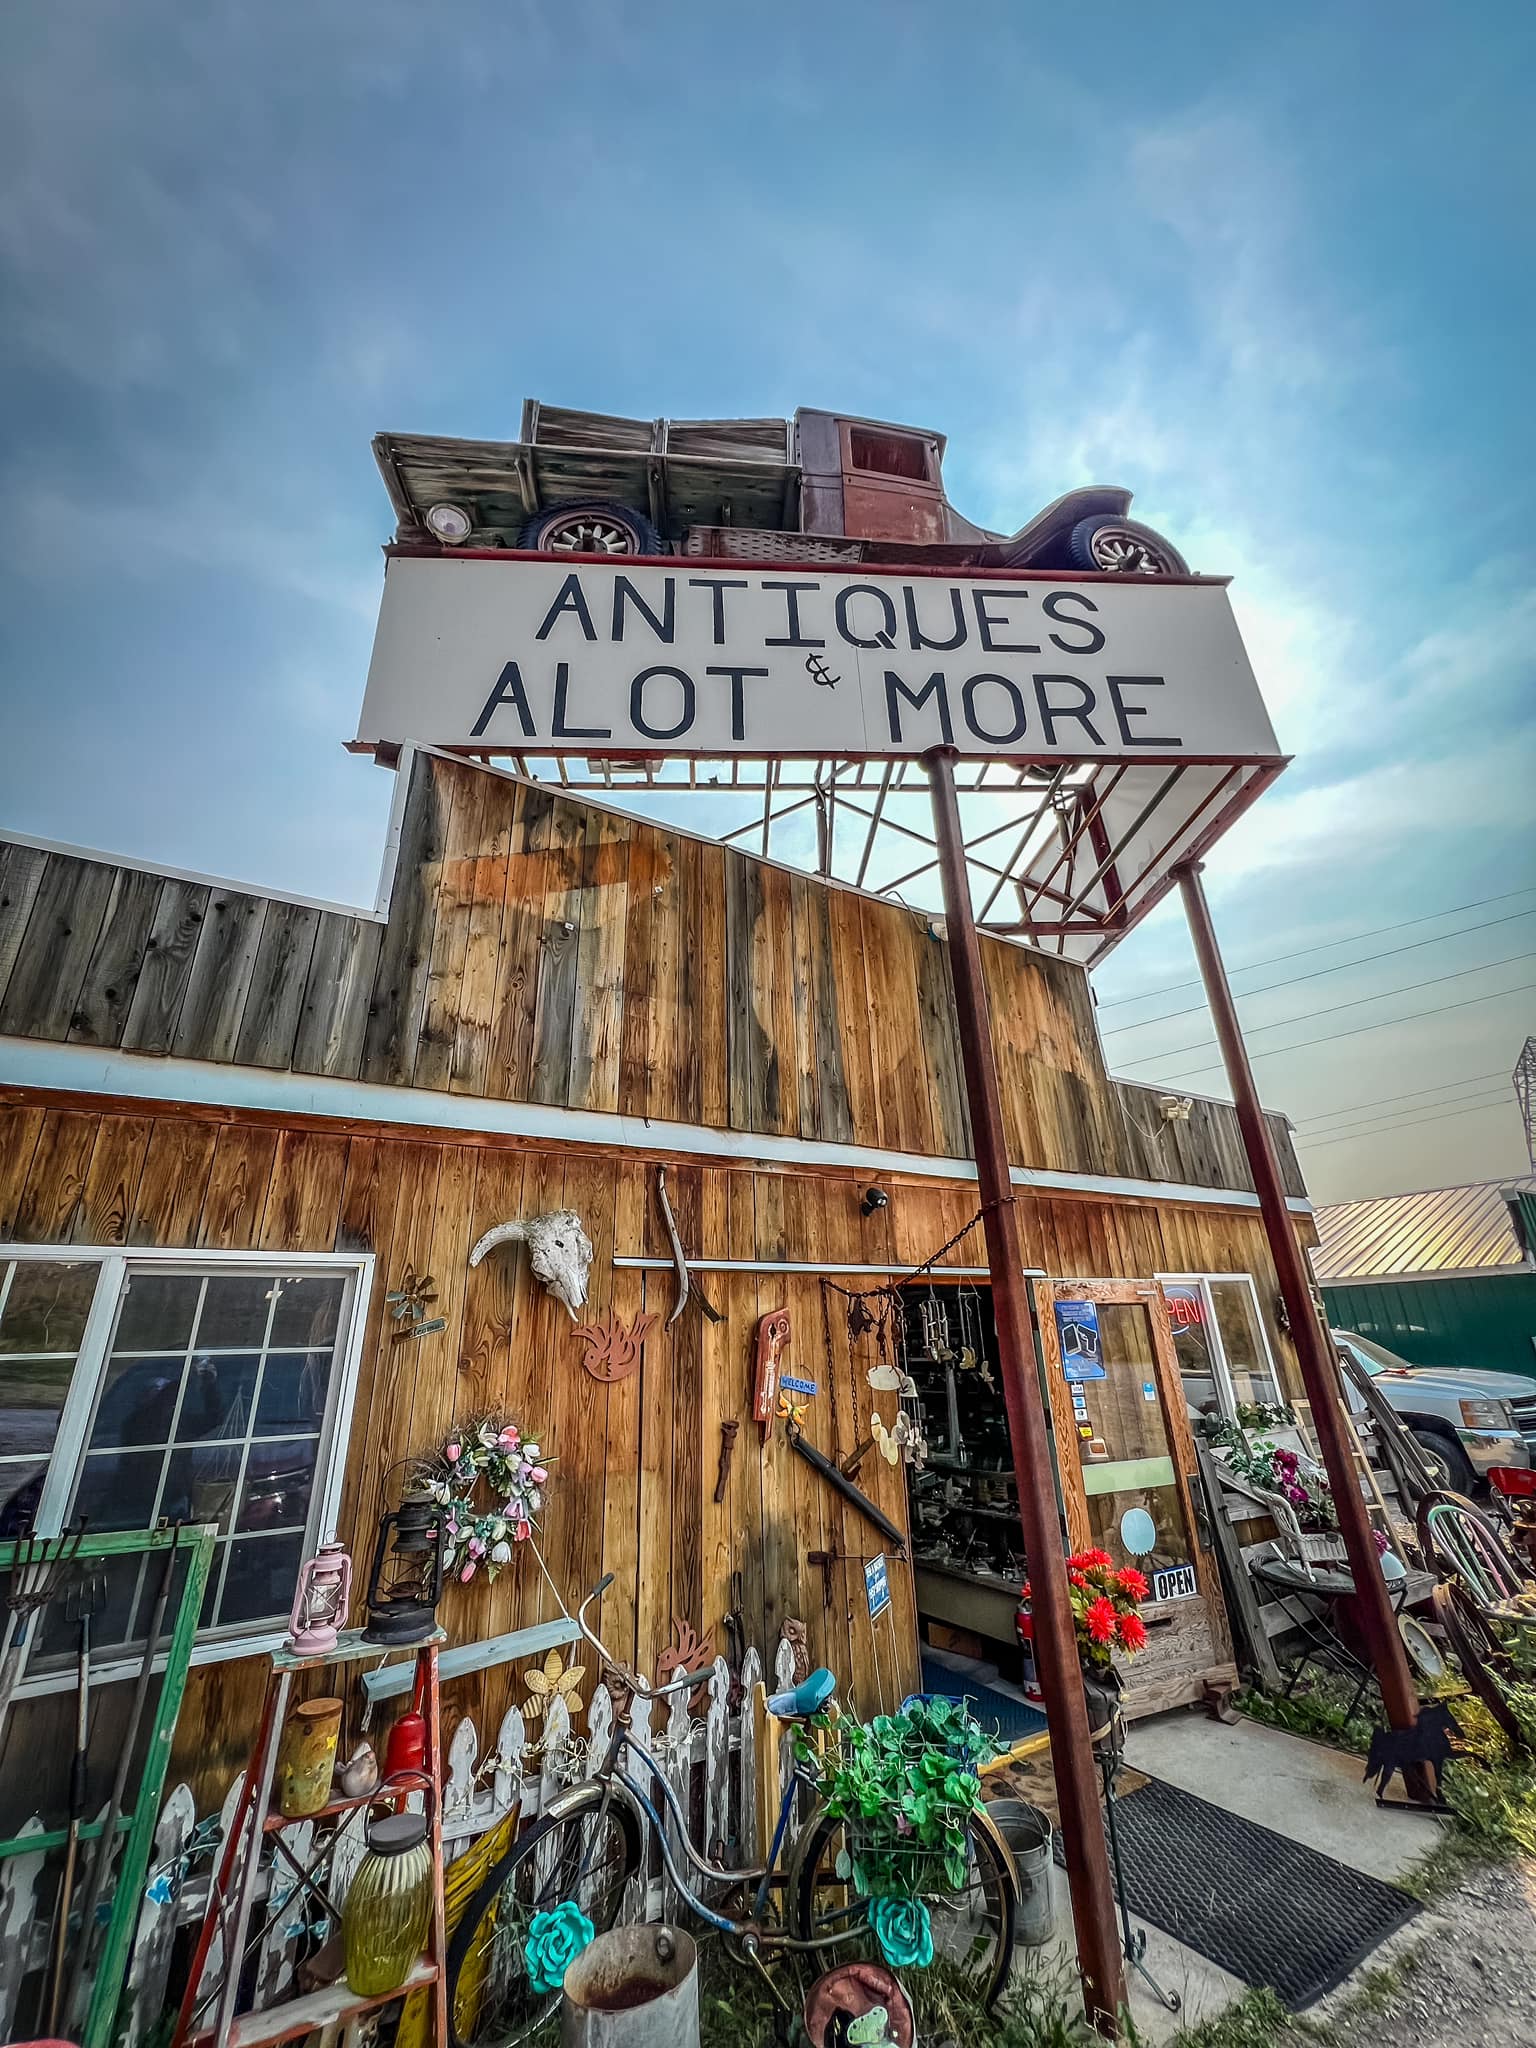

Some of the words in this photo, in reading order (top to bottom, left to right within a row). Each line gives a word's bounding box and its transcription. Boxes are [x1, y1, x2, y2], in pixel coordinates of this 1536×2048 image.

[534, 573, 1106, 655] ANTIQUES
[470, 661, 769, 740] ALOT
[805, 653, 841, 689] &
[885, 671, 1182, 746] MORE
[1165, 1297, 1200, 1324] PEN
[782, 1377, 815, 1392] WELCOME
[1158, 1568, 1194, 1599] OPEN
